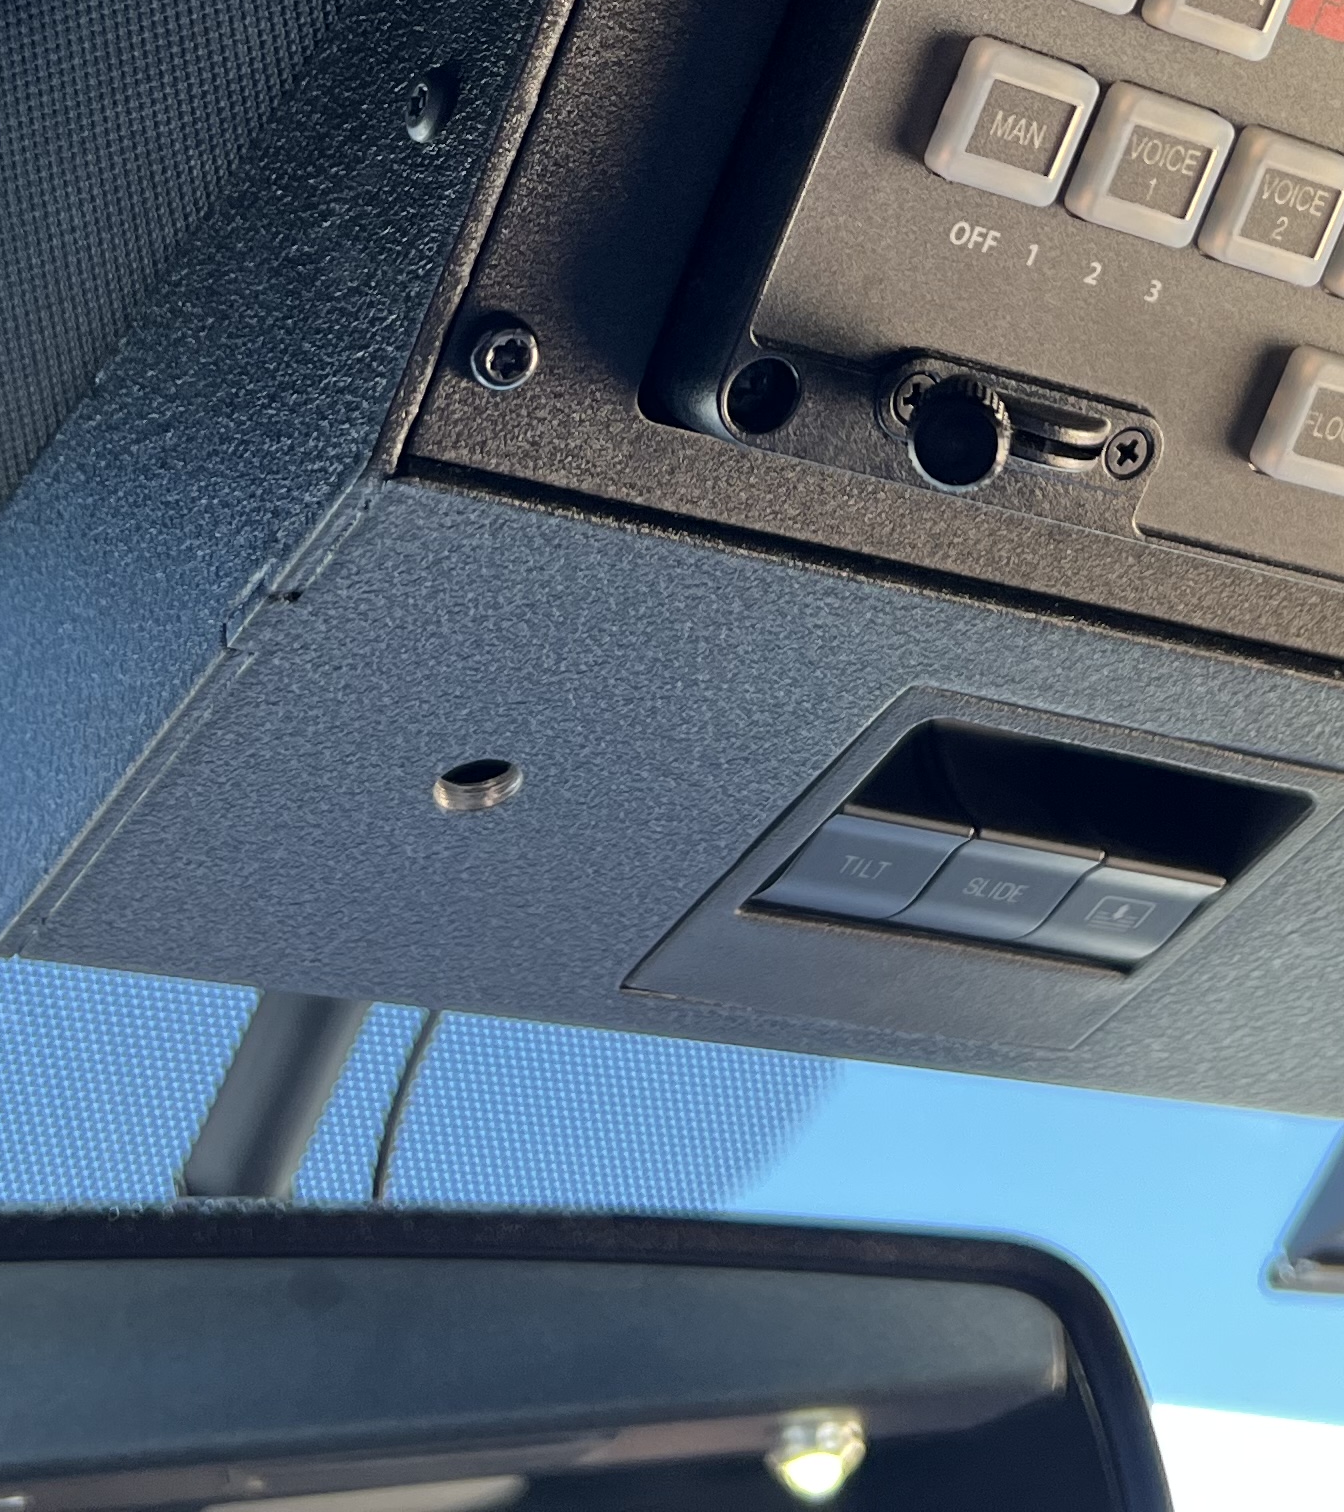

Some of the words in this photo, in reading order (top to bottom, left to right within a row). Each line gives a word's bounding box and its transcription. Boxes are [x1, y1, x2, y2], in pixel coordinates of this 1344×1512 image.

[989, 110, 1047, 149] MAN
[1131, 134, 1202, 176] VOICE
[1145, 178, 1157, 201] 1
[1259, 174, 1330, 217] VOICE
[1272, 217, 1288, 240] 2
[949, 221, 1001, 254] OFF
[1024, 244, 1040, 267] 1
[1084, 262, 1102, 285] 2
[1144, 280, 1163, 303] 3
[838, 854, 893, 882] TILT
[962, 877, 1027, 904] SLIDE
